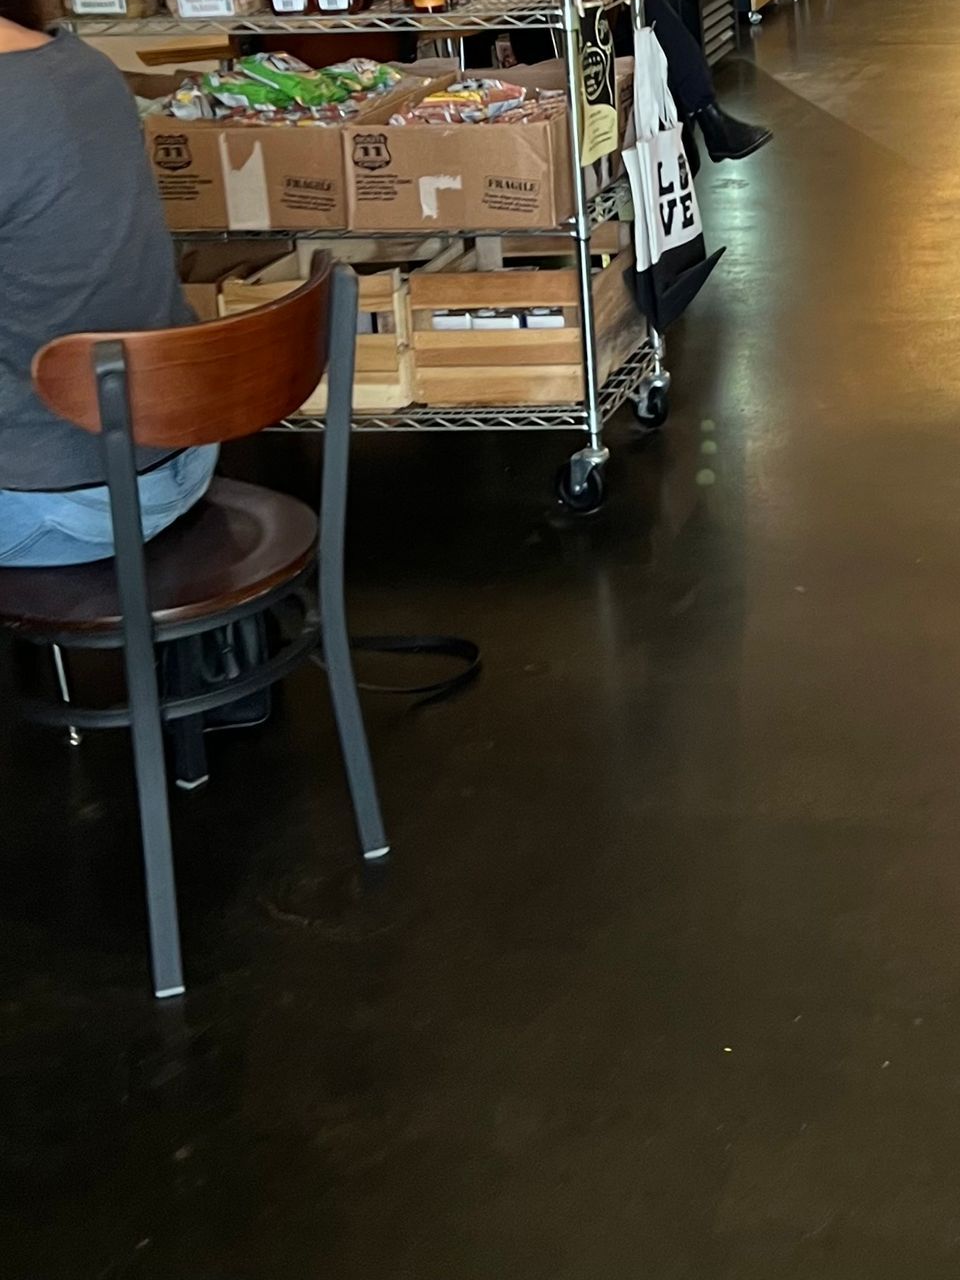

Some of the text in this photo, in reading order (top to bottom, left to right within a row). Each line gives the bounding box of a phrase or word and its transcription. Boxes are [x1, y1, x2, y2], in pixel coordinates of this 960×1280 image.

[359, 146, 382, 157] 11
[285, 178, 333, 191] FRAGILE
[488, 178, 537, 192] FRAGILE
